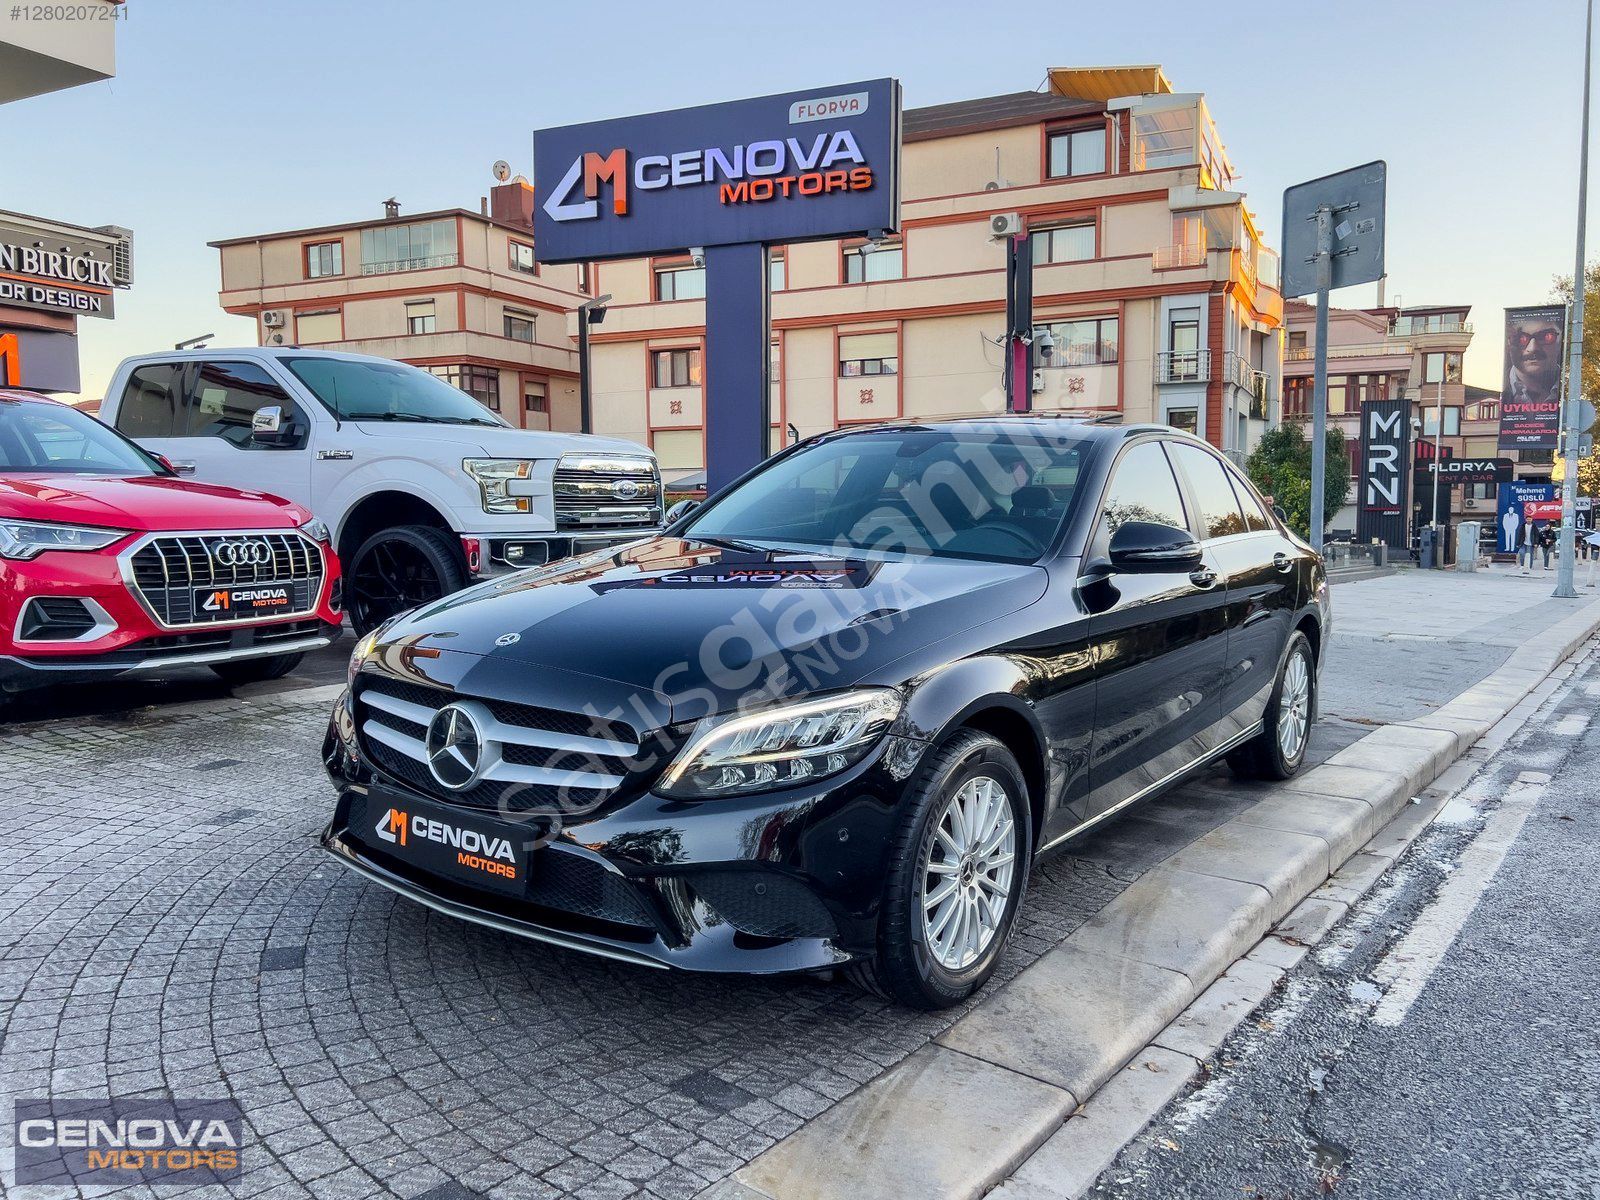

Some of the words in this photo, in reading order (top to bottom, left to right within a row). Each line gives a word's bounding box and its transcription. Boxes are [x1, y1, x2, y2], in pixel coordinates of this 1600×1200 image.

[798, 98, 860, 119] FLORYA
[634, 129, 866, 190] CENOVA
[719, 166, 873, 205] MOTORS
[33, 286, 102, 312] DESIGN
[1504, 402, 1558, 413] UYKUCU
[1367, 410, 1402, 506] MRN
[1428, 462, 1497, 472] FLORYA
[1517, 494, 1545, 502] SÜSLÜ
[231, 588, 288, 602] CENOVA
[252, 598, 288, 607] MOTORS
[411, 814, 517, 864] CENOVA
[457, 851, 517, 880] MOTORS
